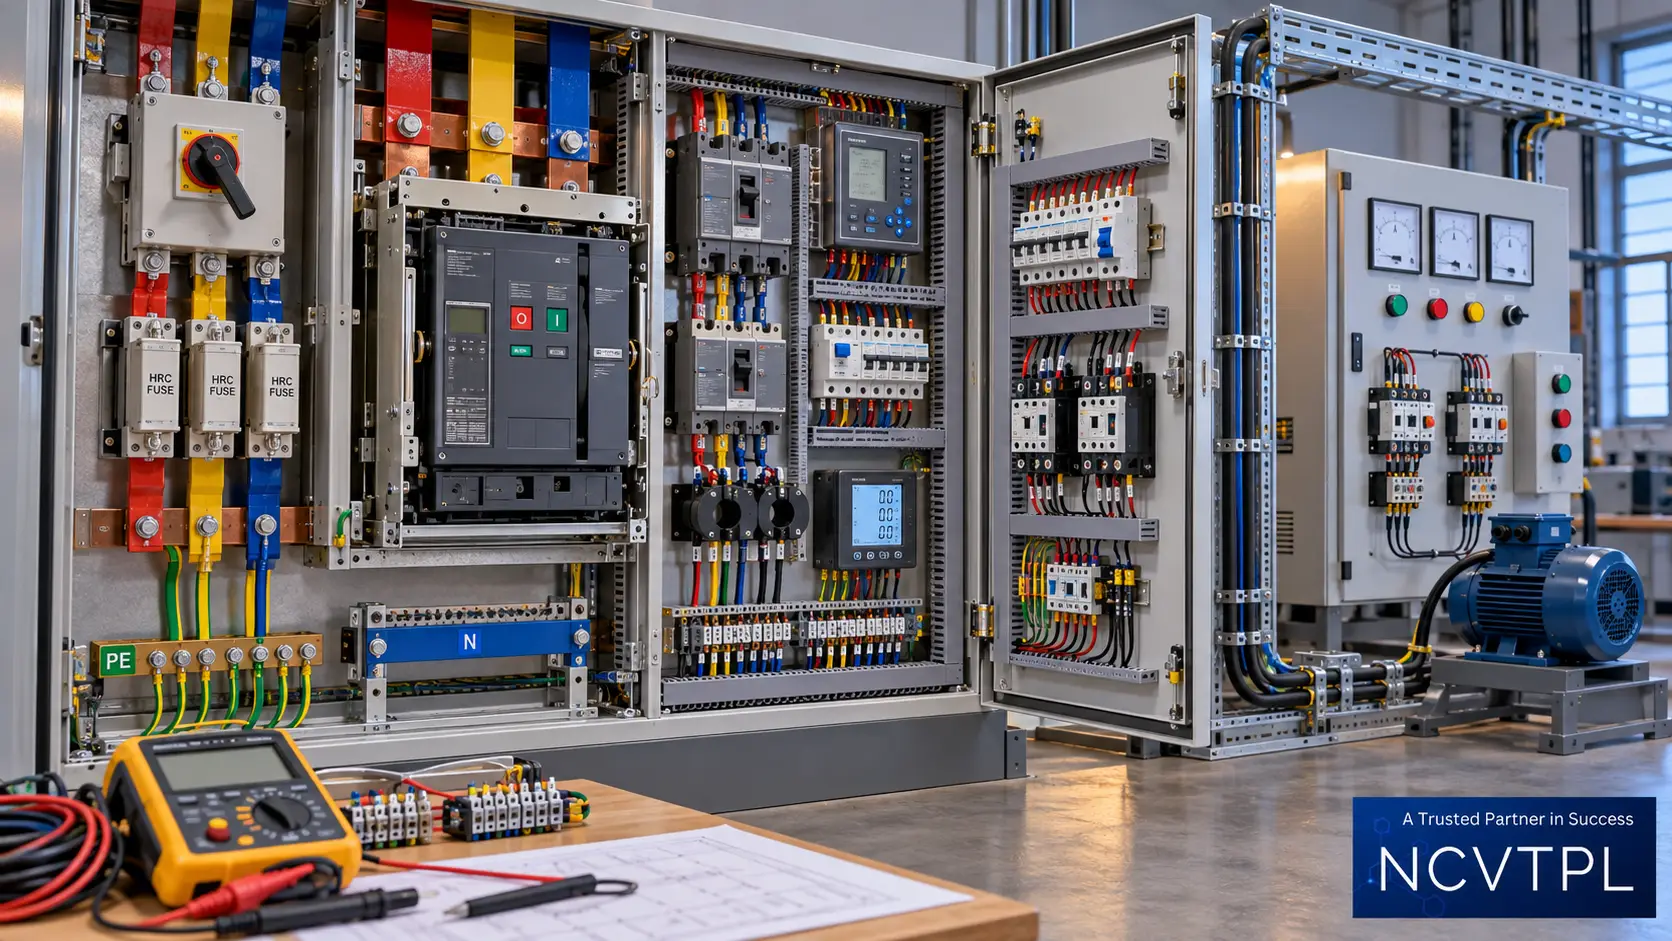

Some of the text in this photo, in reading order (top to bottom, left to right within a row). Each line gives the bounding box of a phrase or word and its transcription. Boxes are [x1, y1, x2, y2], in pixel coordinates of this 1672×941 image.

[149, 373, 172, 383] HRC
[212, 375, 234, 385] HRC
[271, 376, 293, 386] HRC
[147, 385, 174, 395] FUSE
[210, 386, 236, 396] FUSE
[269, 387, 295, 397] FUSE
[464, 633, 476, 650] N
[106, 652, 131, 670] PE
